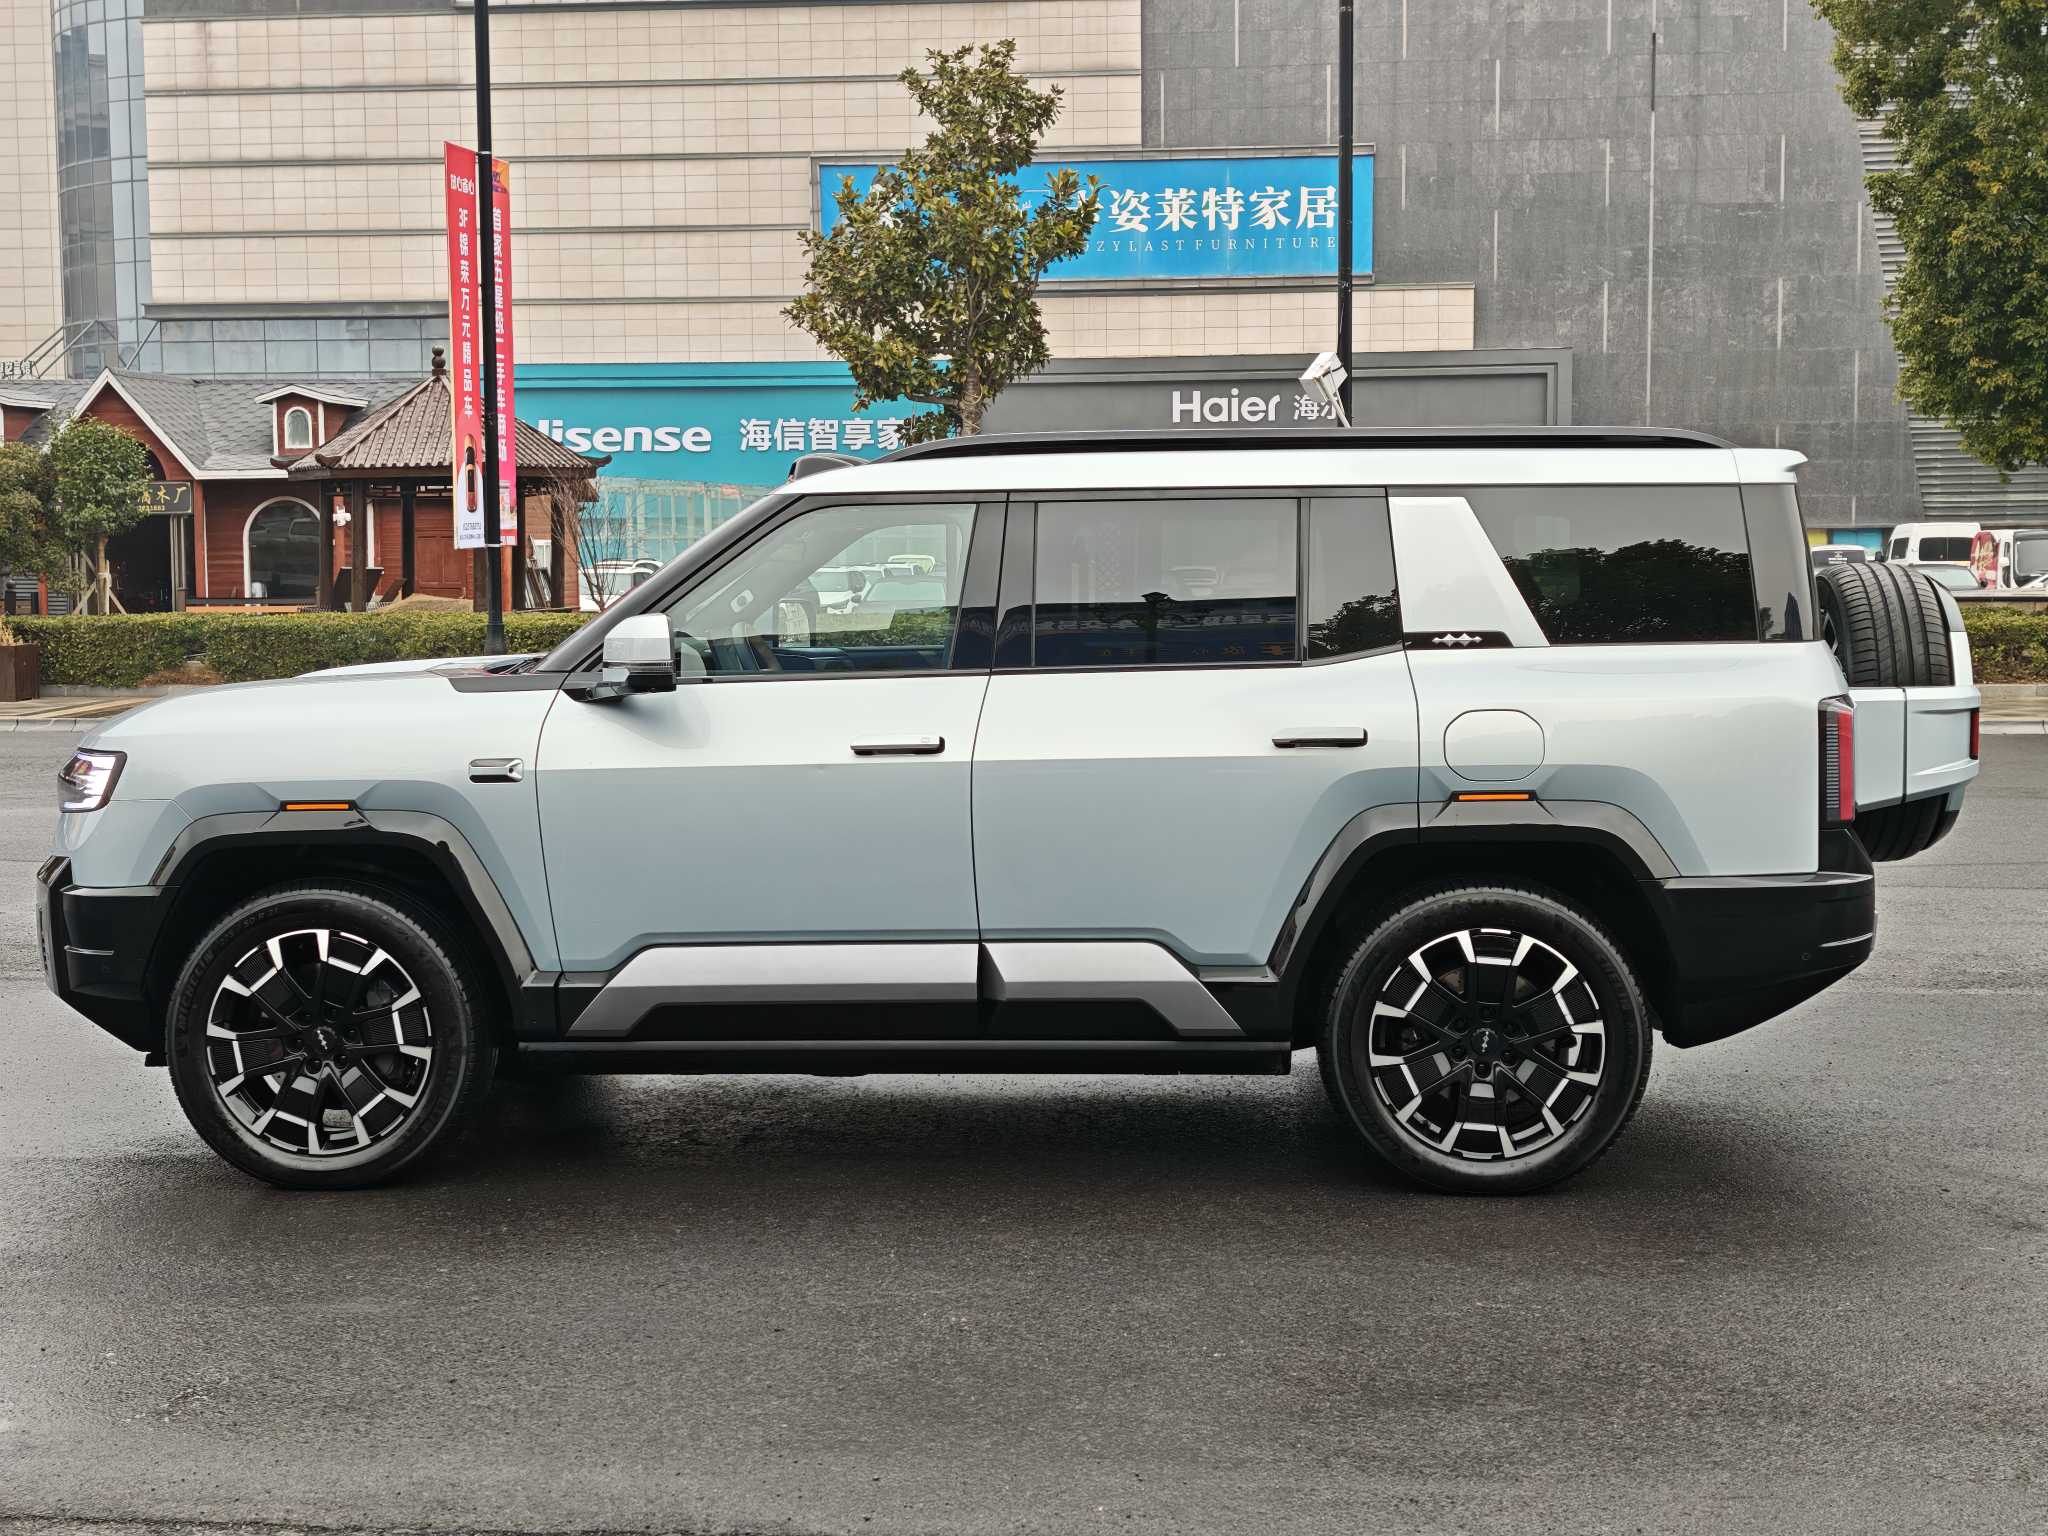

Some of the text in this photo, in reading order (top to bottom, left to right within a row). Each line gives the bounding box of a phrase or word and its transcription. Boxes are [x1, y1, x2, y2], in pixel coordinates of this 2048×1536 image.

[1173, 387, 1281, 423] Haier
[739, 417, 906, 451] 海信智享家
